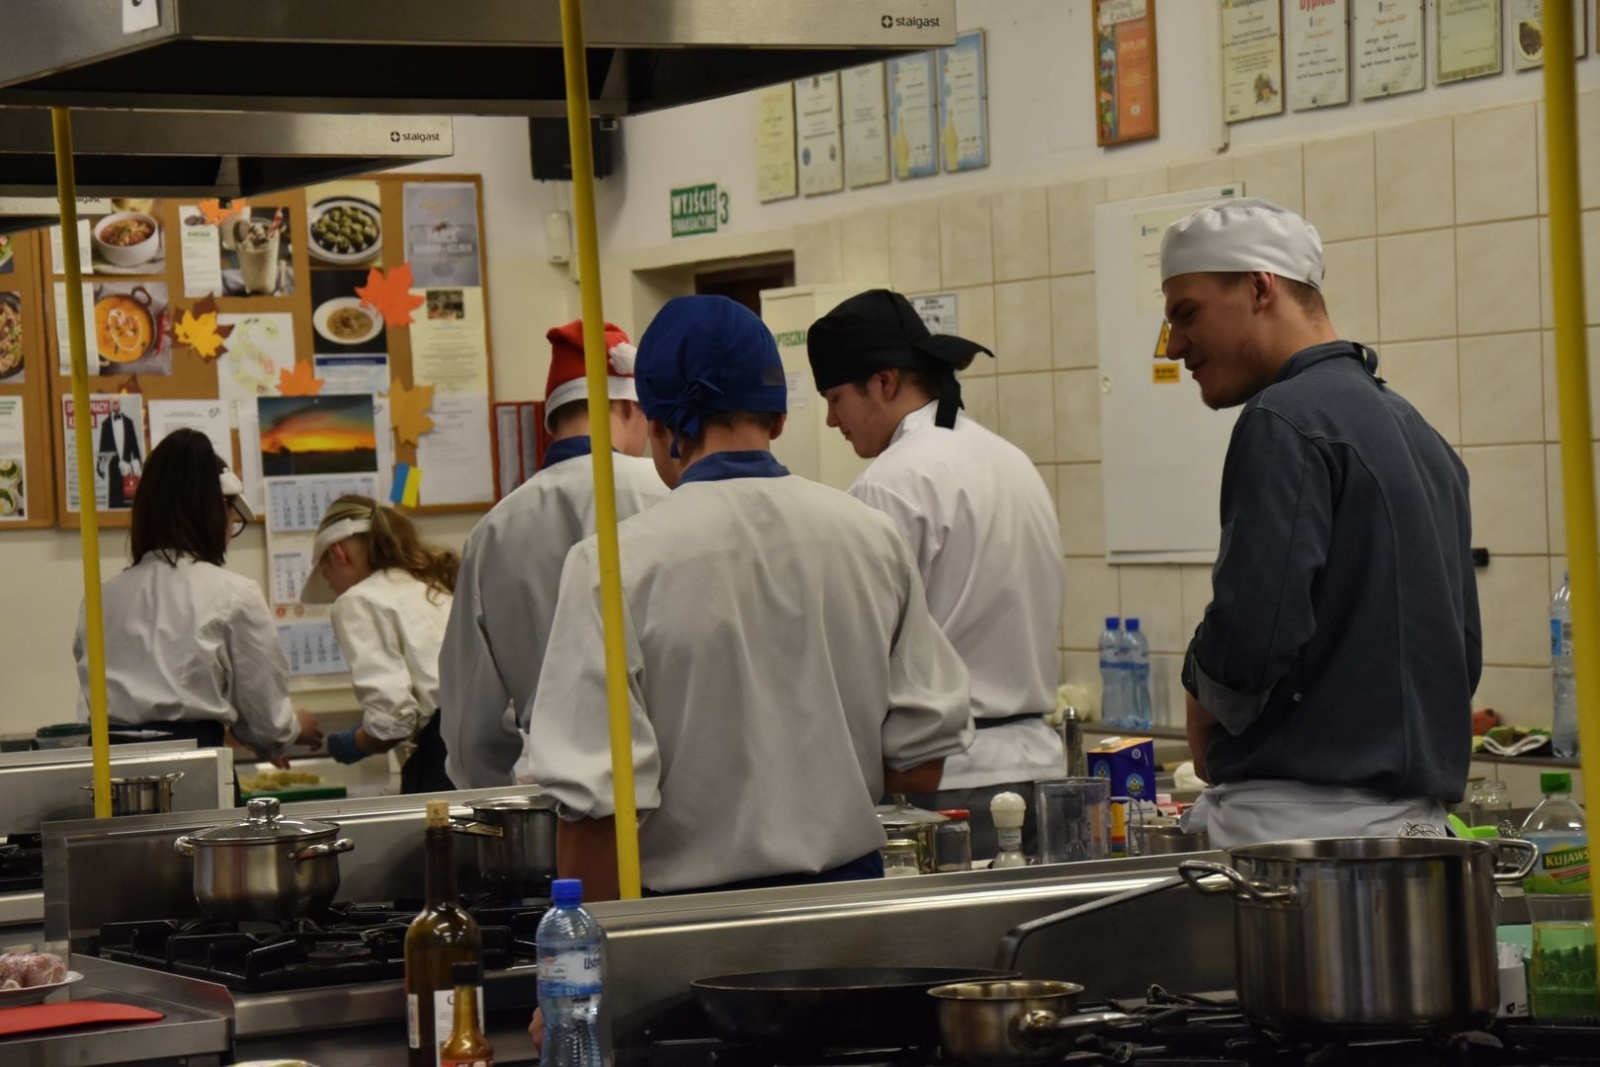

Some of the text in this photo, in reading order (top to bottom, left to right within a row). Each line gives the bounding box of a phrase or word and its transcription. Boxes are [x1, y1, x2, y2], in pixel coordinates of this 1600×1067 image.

[895, 16, 940, 30] stalgast
[402, 132, 440, 143] stalgast
[672, 187, 729, 225] WYJŚCIE 3
[1545, 850, 1590, 867] KUJAWS
